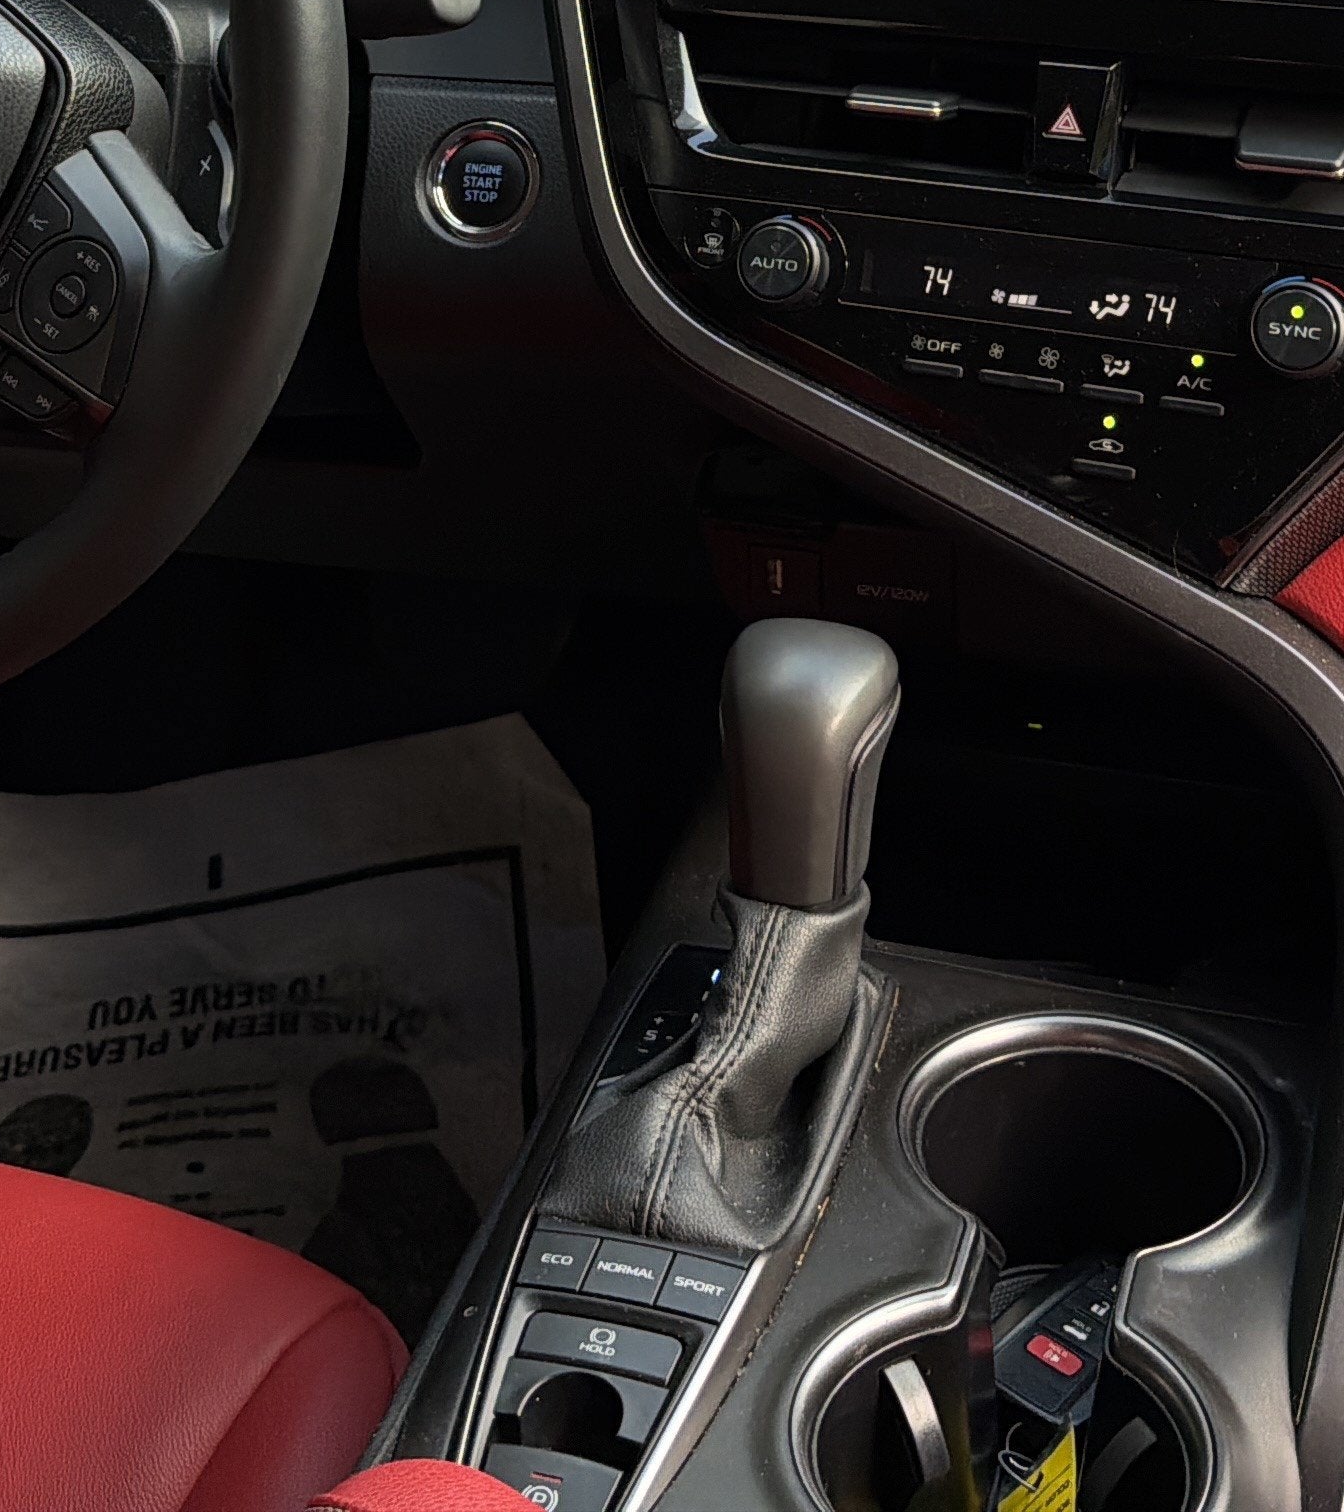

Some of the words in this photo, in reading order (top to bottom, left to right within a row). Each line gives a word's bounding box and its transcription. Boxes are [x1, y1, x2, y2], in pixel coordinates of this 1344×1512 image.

[464, 162, 503, 176] ENGINE
[462, 175, 503, 190] START
[464, 189, 499, 203] STOP
[749, 256, 799, 272] AUTO
[923, 265, 954, 296] 74
[1145, 293, 1177, 325] 74
[1268, 322, 1322, 341] SYNC
[927, 339, 963, 355] OFF
[1176, 374, 1212, 391] A/C
[169, 981, 278, 1019] SERVE
[87, 993, 158, 1031] YOU
[180, 1022, 205, 1050] A
[212, 1011, 299, 1043] BEEN
[643, 1029, 659, 1041] S
[540, 1252, 574, 1266] ECO
[597, 1260, 655, 1280] NORMAL
[673, 1275, 726, 1297] SPORT
[578, 1341, 616, 1357] HOLD
